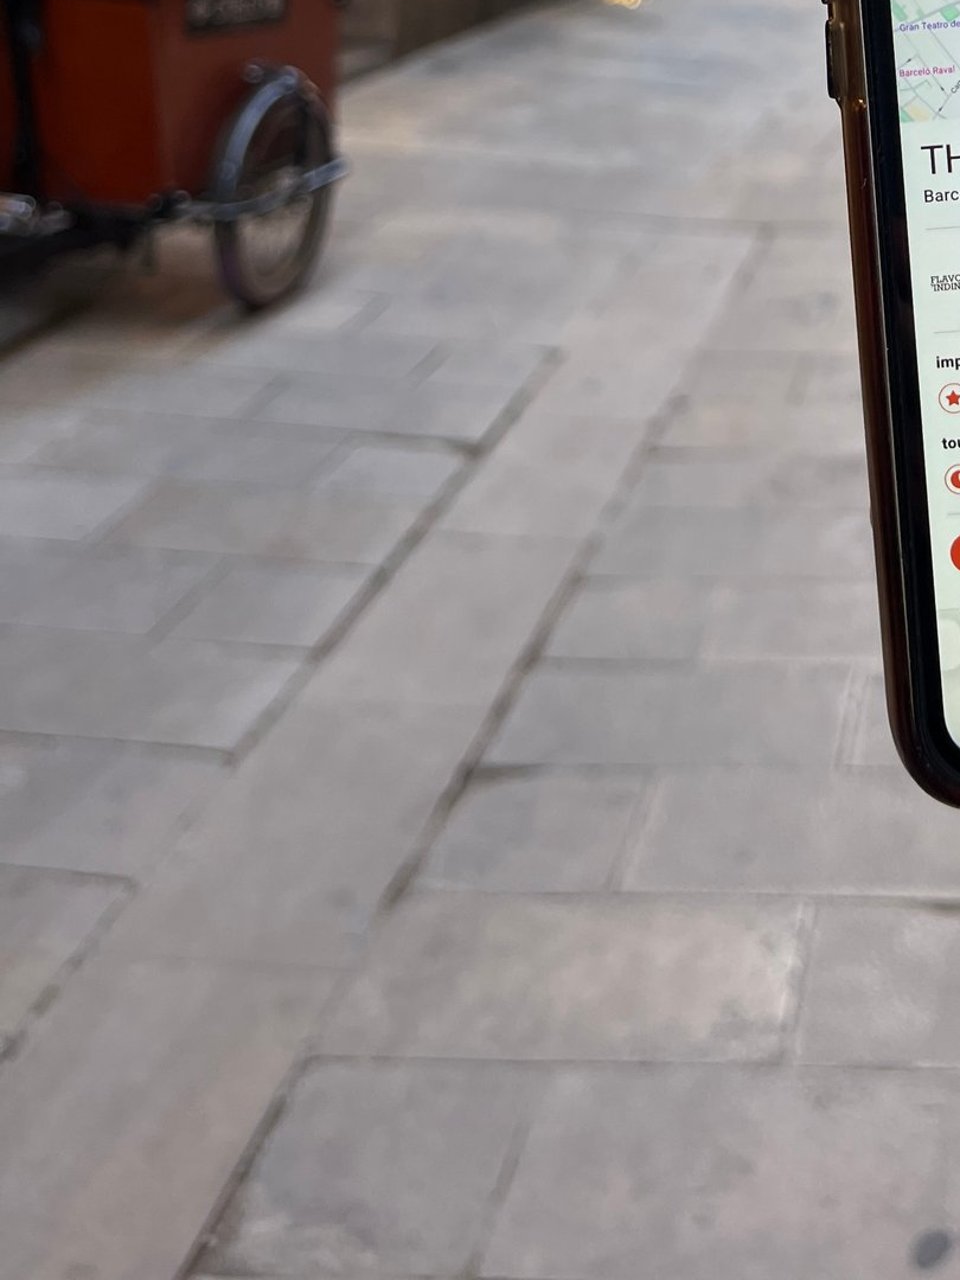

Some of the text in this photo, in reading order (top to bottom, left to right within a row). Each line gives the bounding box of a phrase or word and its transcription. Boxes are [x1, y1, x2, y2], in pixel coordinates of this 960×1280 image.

[899, 23, 919, 32] Gran
[922, 21, 949, 30] Teatro
[932, 65, 956, 75] Raval
